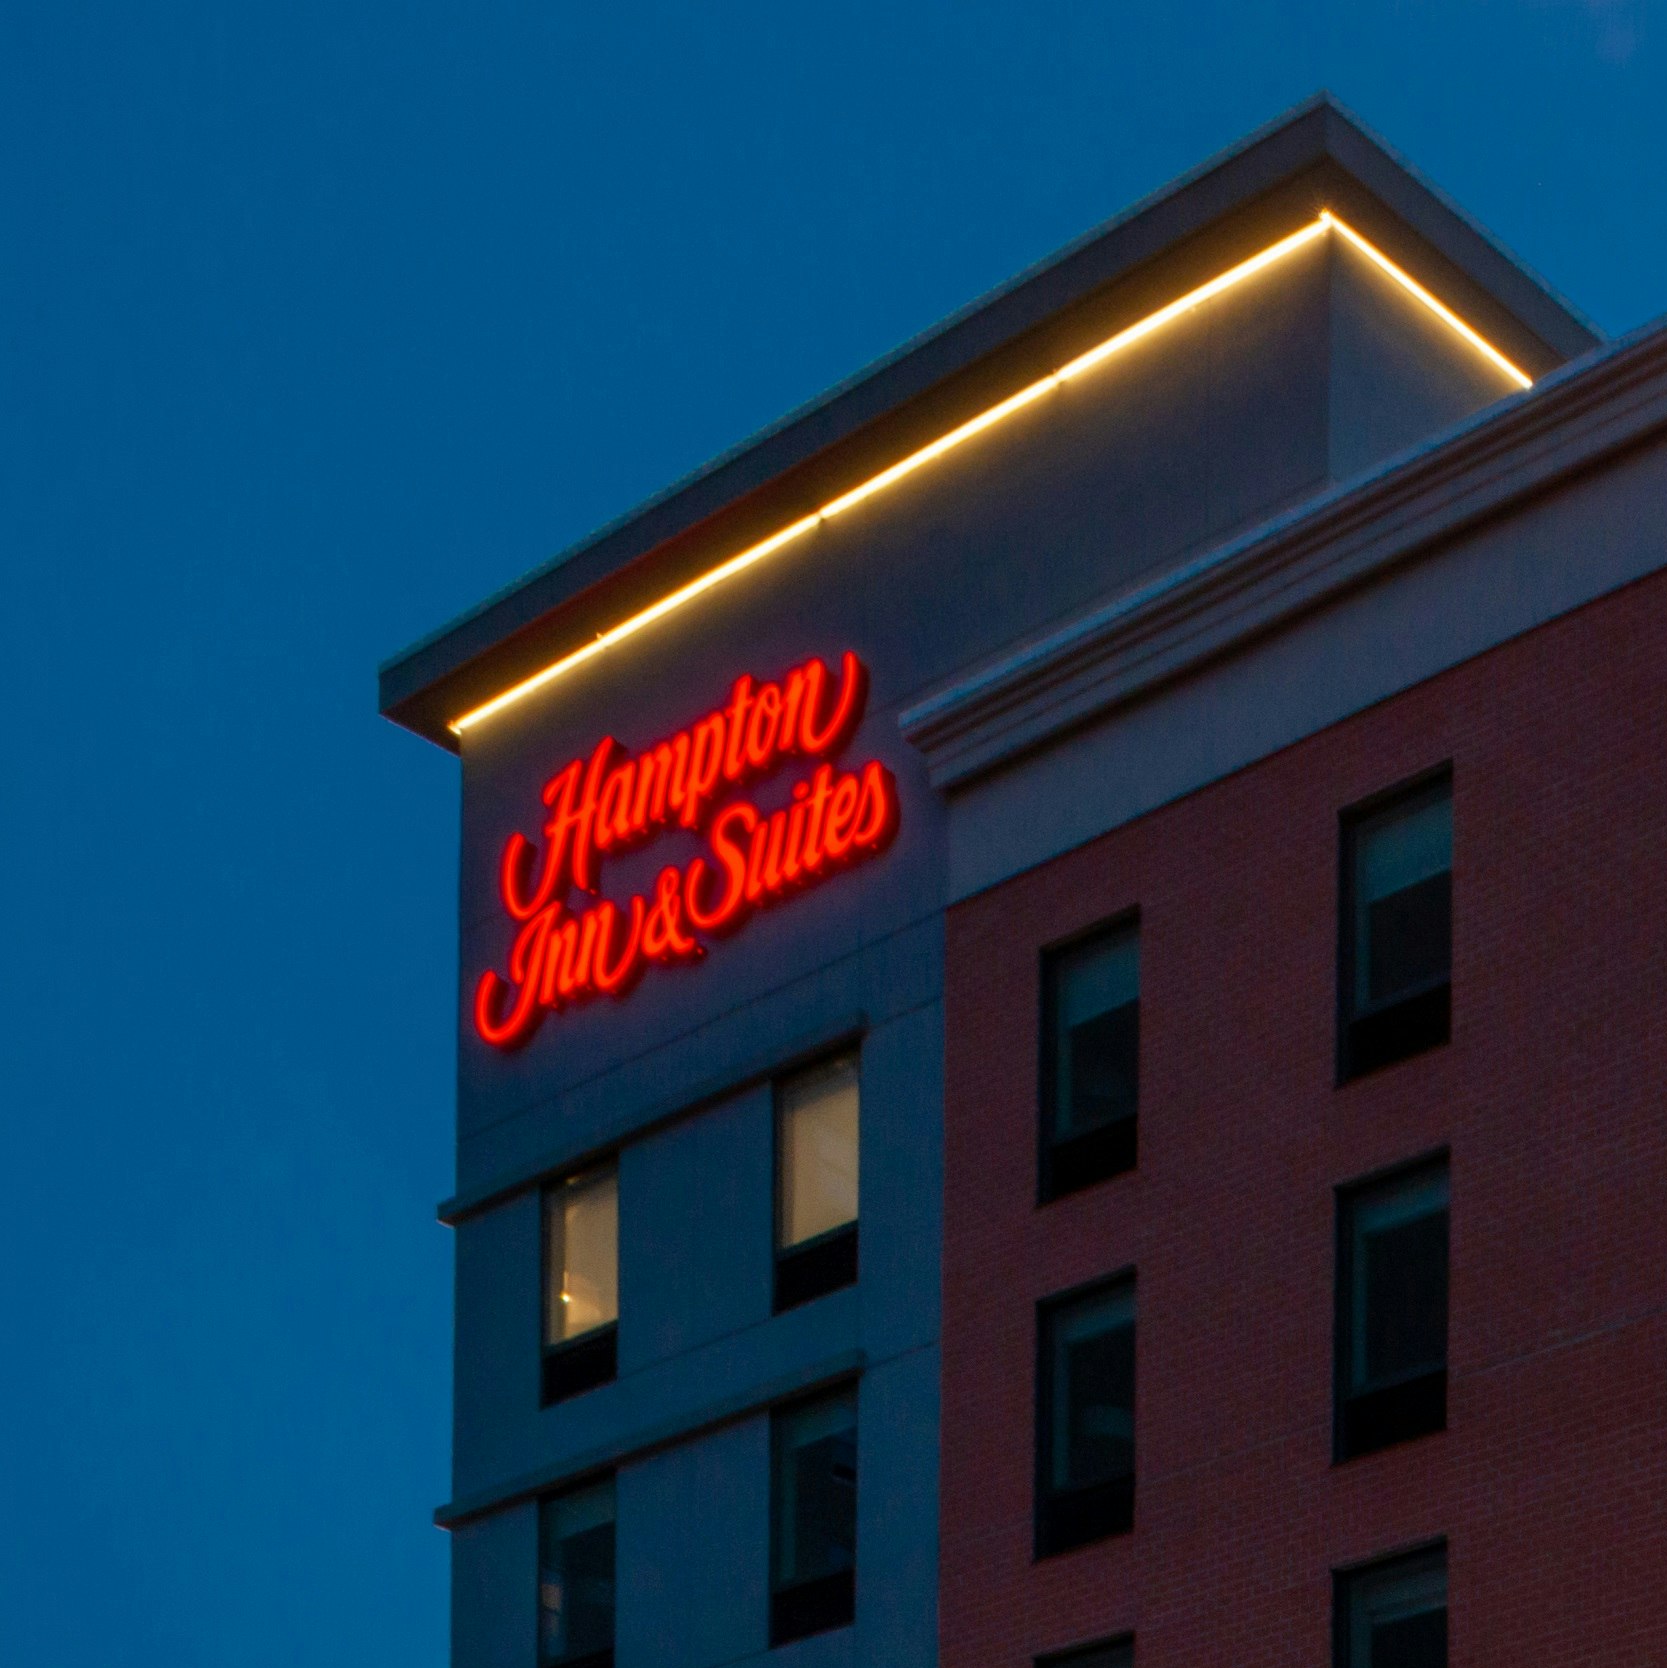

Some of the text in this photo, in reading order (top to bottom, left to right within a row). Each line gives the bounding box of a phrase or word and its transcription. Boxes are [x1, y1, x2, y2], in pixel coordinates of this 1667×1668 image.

[474, 759, 888, 1043] Inn & Suites
[502, 649, 861, 921] Hampton
